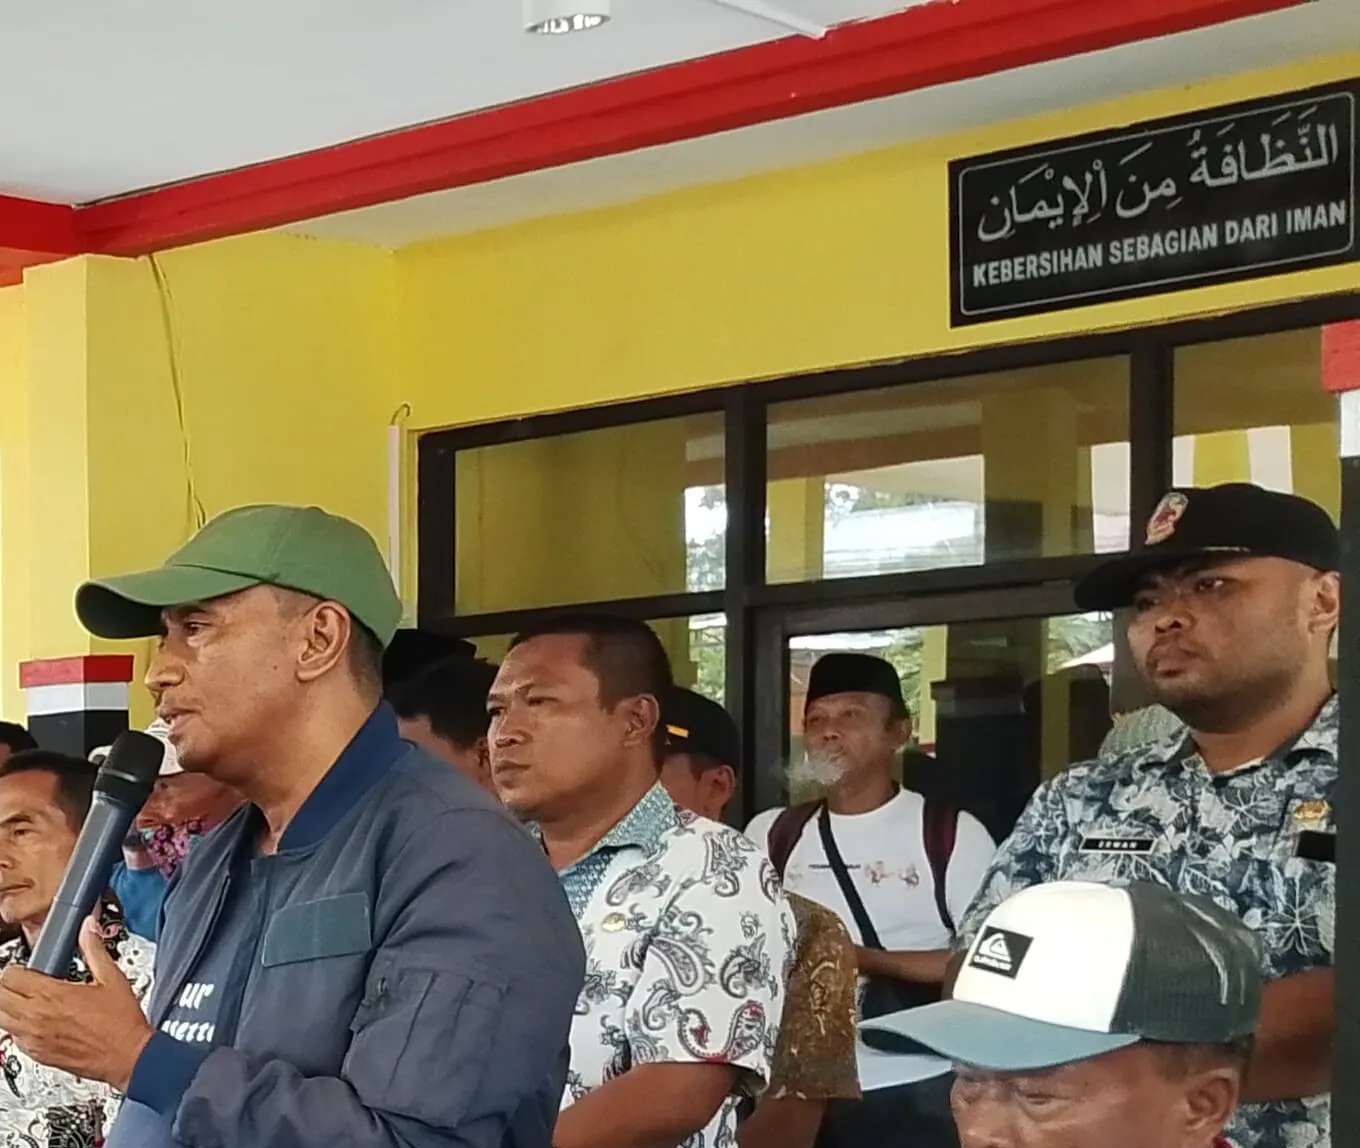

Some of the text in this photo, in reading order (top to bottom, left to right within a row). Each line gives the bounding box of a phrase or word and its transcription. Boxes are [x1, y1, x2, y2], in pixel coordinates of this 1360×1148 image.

[972, 200, 1347, 287] KEBERSIHAN SEBAGIAN DARI IMAN
